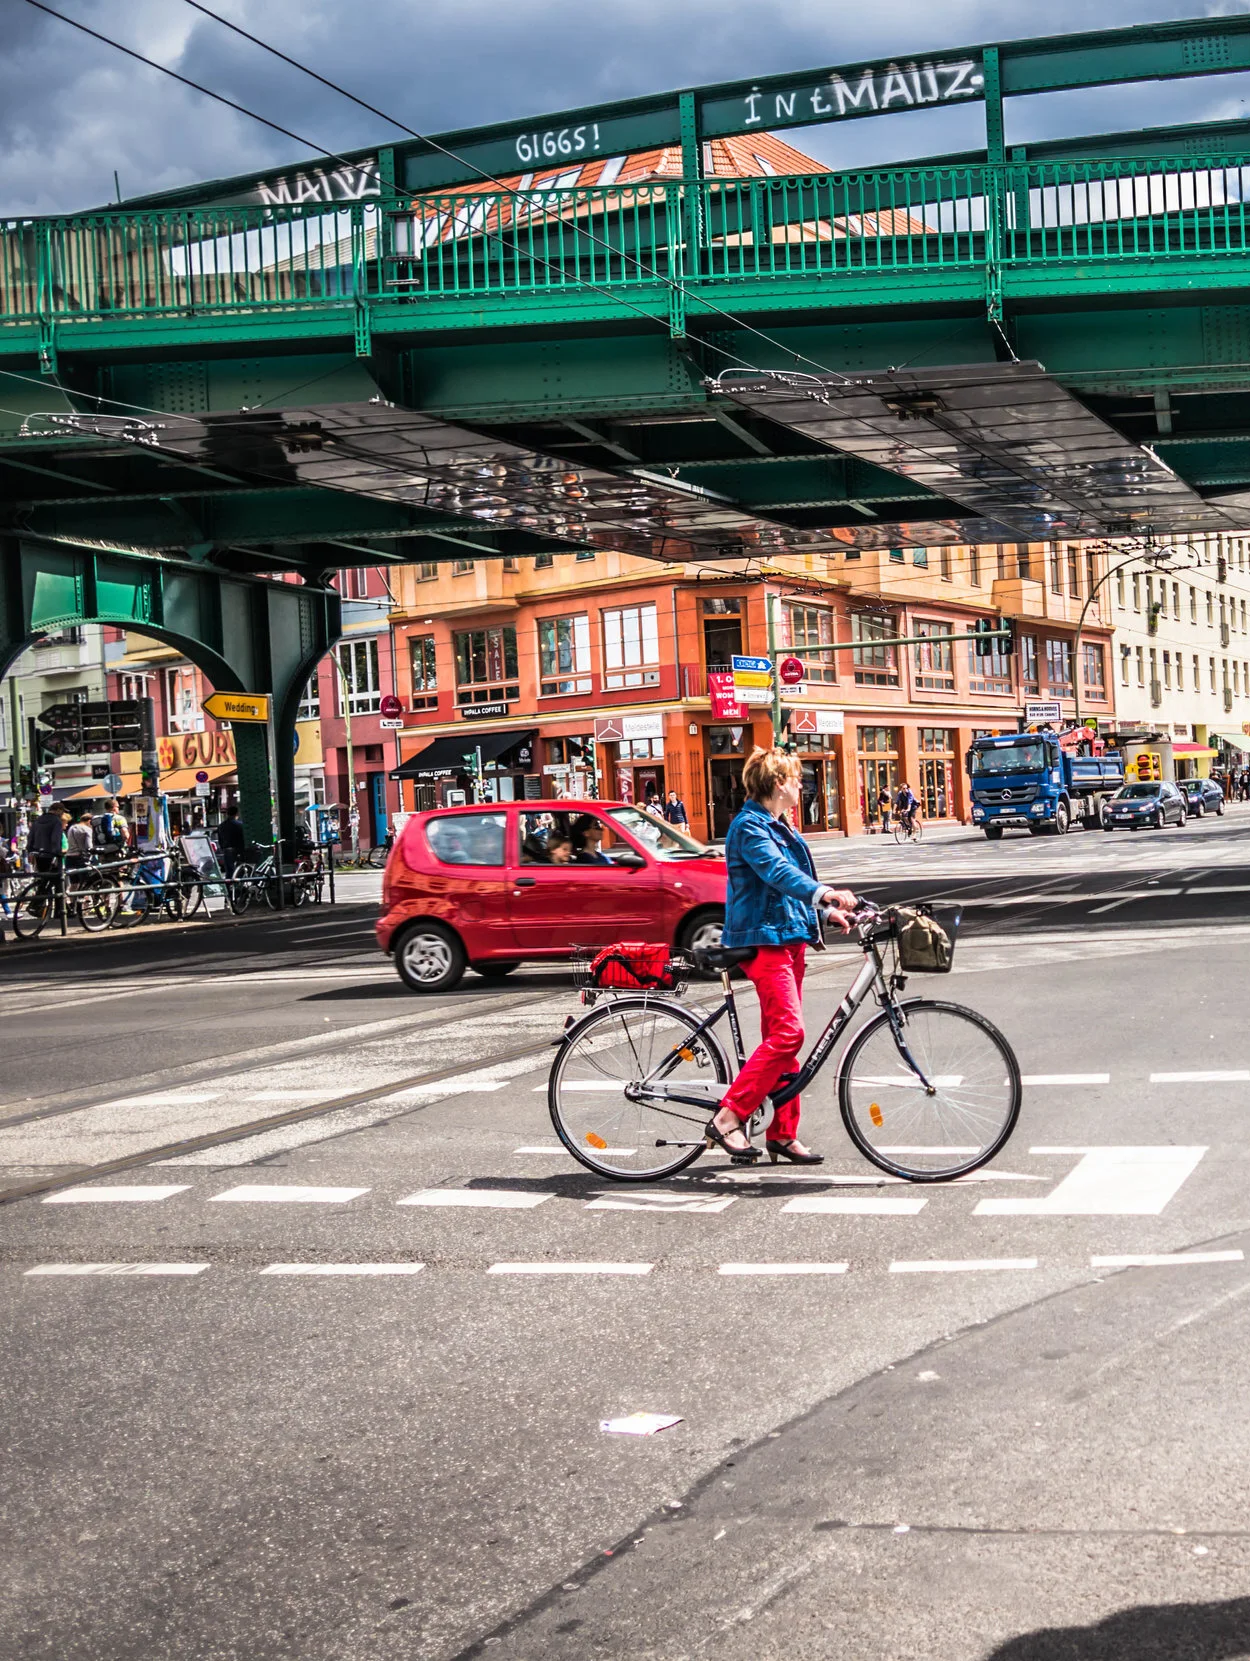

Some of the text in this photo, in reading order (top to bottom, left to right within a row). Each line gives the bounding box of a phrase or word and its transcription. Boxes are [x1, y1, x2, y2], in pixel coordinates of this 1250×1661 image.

[516, 123, 600, 161] GIGGS!
[493, 639, 501, 681] SALE
[224, 701, 257, 716] Wedding
[481, 704, 502, 714] COFFEE
[434, 769, 452, 777] COFFEE
